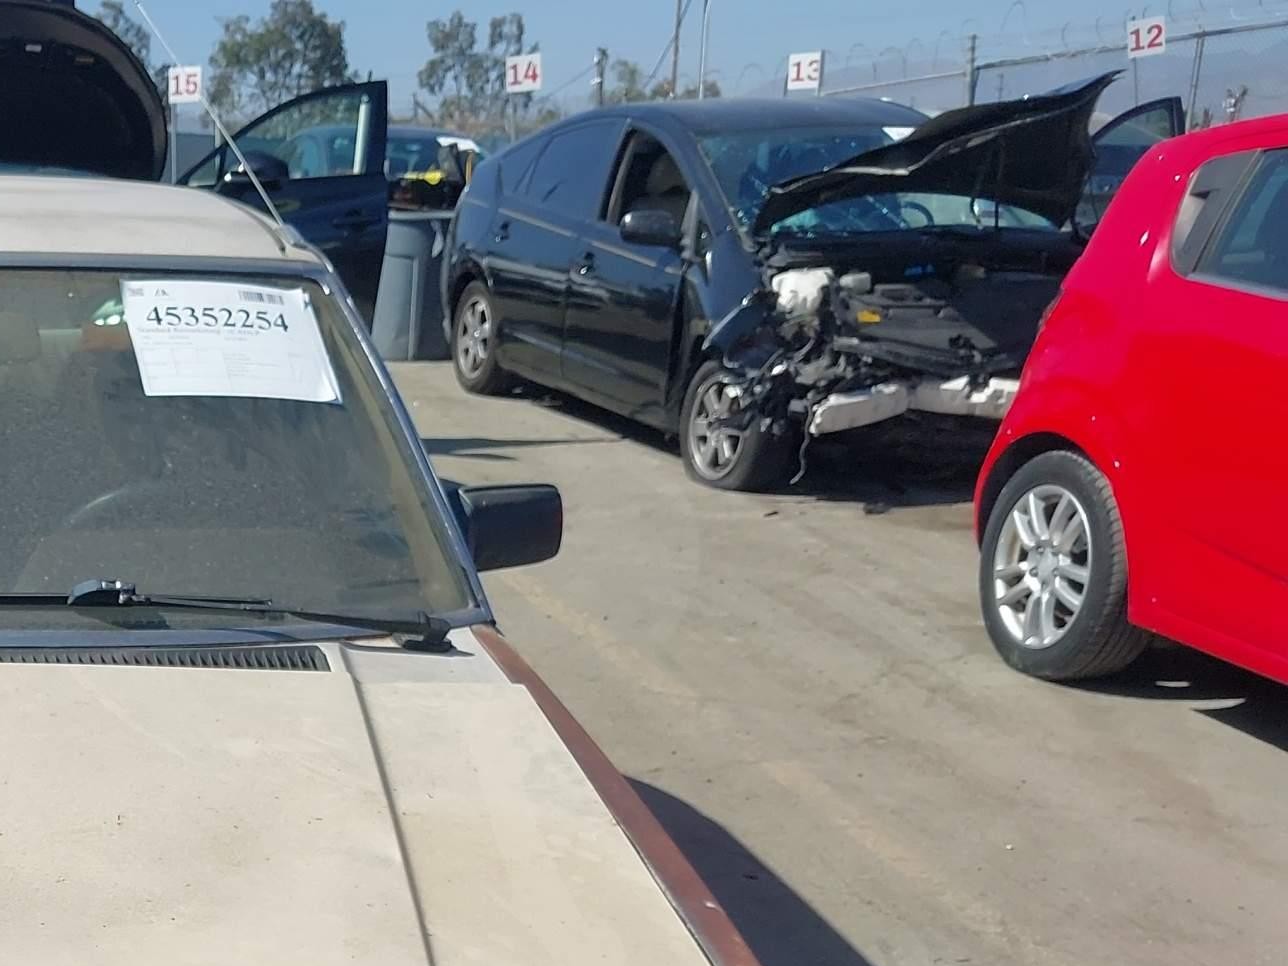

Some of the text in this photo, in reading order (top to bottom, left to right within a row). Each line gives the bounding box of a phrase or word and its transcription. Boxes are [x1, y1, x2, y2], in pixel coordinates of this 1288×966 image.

[1128, 24, 1164, 51] 12
[508, 63, 539, 86] 14
[790, 61, 820, 83] 13
[171, 74, 199, 95] 15
[146, 306, 289, 332] 45352254
